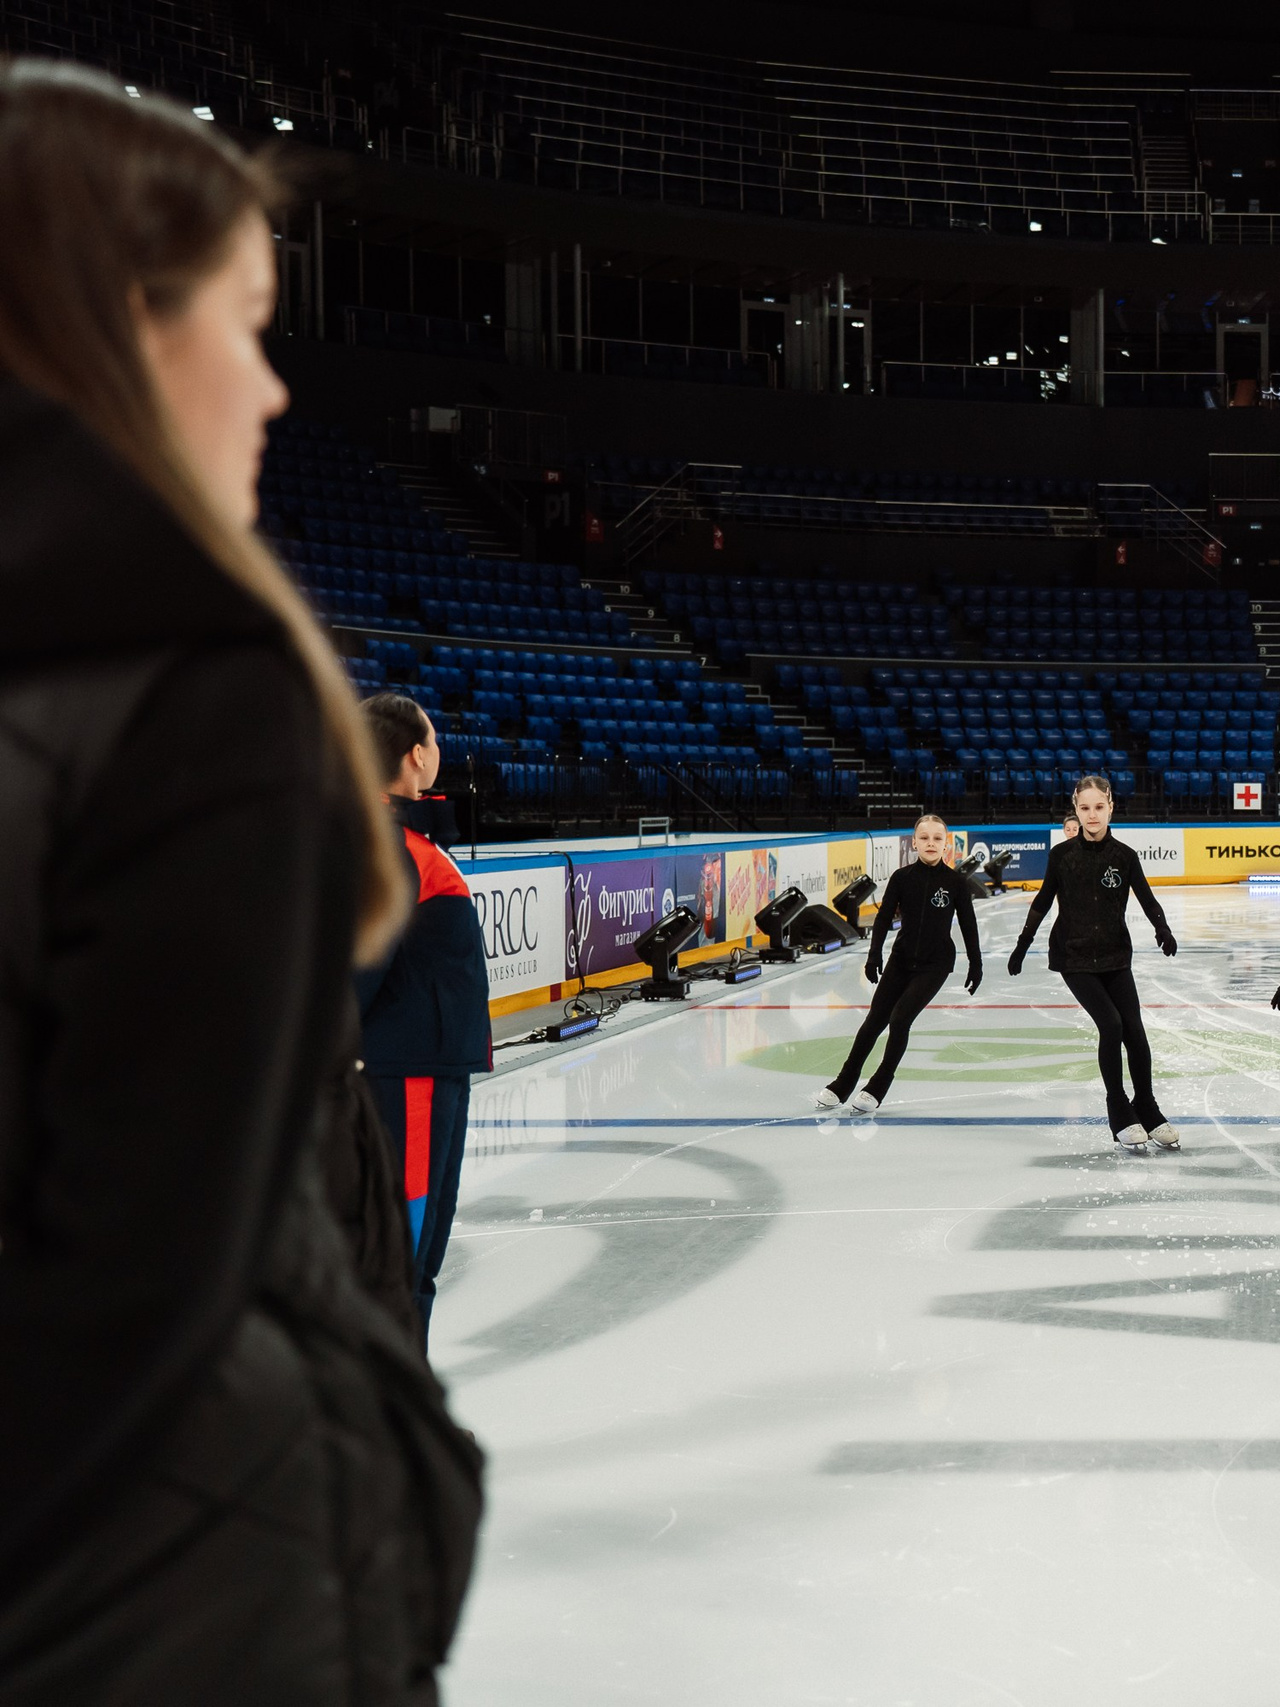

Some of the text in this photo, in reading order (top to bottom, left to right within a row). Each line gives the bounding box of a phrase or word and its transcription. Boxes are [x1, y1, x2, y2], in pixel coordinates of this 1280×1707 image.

[547, 472, 559, 482] P1
[1222, 506, 1233, 515] P1
[620, 585, 631, 594] 10
[1251, 604, 1262, 612] 10
[647, 609, 655, 618] 9
[1254, 624, 1262, 633] 9
[673, 634, 681, 643] 8
[1259, 646, 1267, 655] 8
[700, 656, 707, 666] 7
[1137, 844, 1177, 860] eridze
[598, 885, 655, 927] Фигурист
[472, 886, 538, 960] RRCC
[489, 959, 538, 982] INESS CLUB
